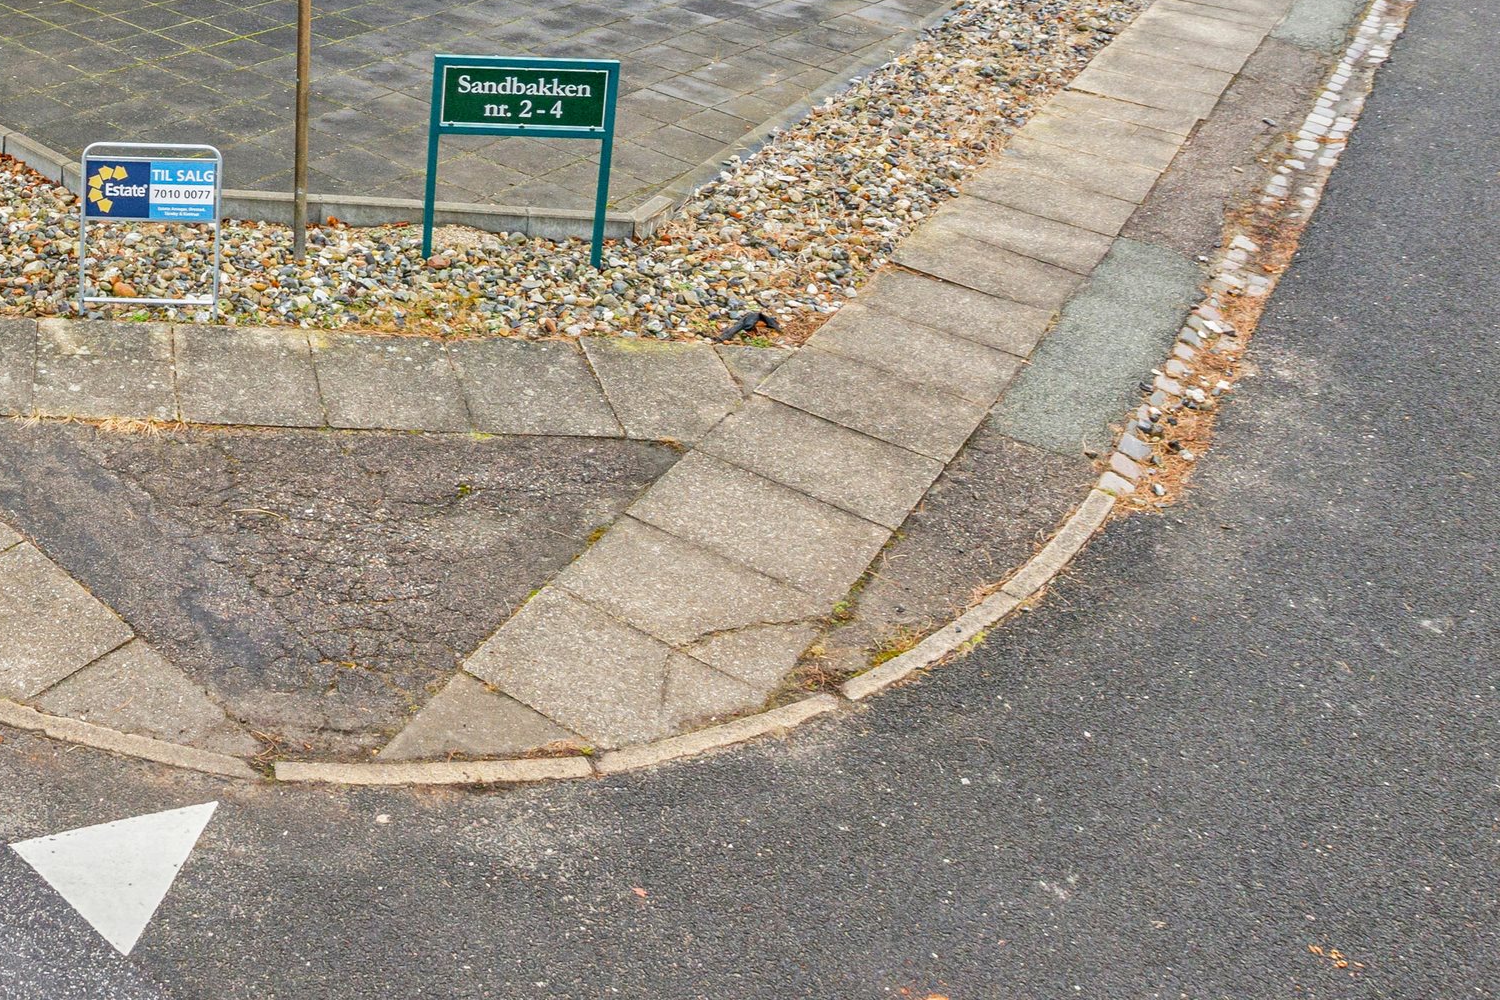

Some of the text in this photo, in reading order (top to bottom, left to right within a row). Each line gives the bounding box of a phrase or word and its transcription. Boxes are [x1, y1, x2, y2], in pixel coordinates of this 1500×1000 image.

[457, 74, 591, 97] Sandbakken
[484, 103, 512, 117] nr.
[518, 100, 533, 118] 2
[550, 100, 563, 118] 4
[152, 169, 214, 182] TIL SALG
[105, 182, 146, 197] Estate
[154, 189, 211, 199] 7010 0077
